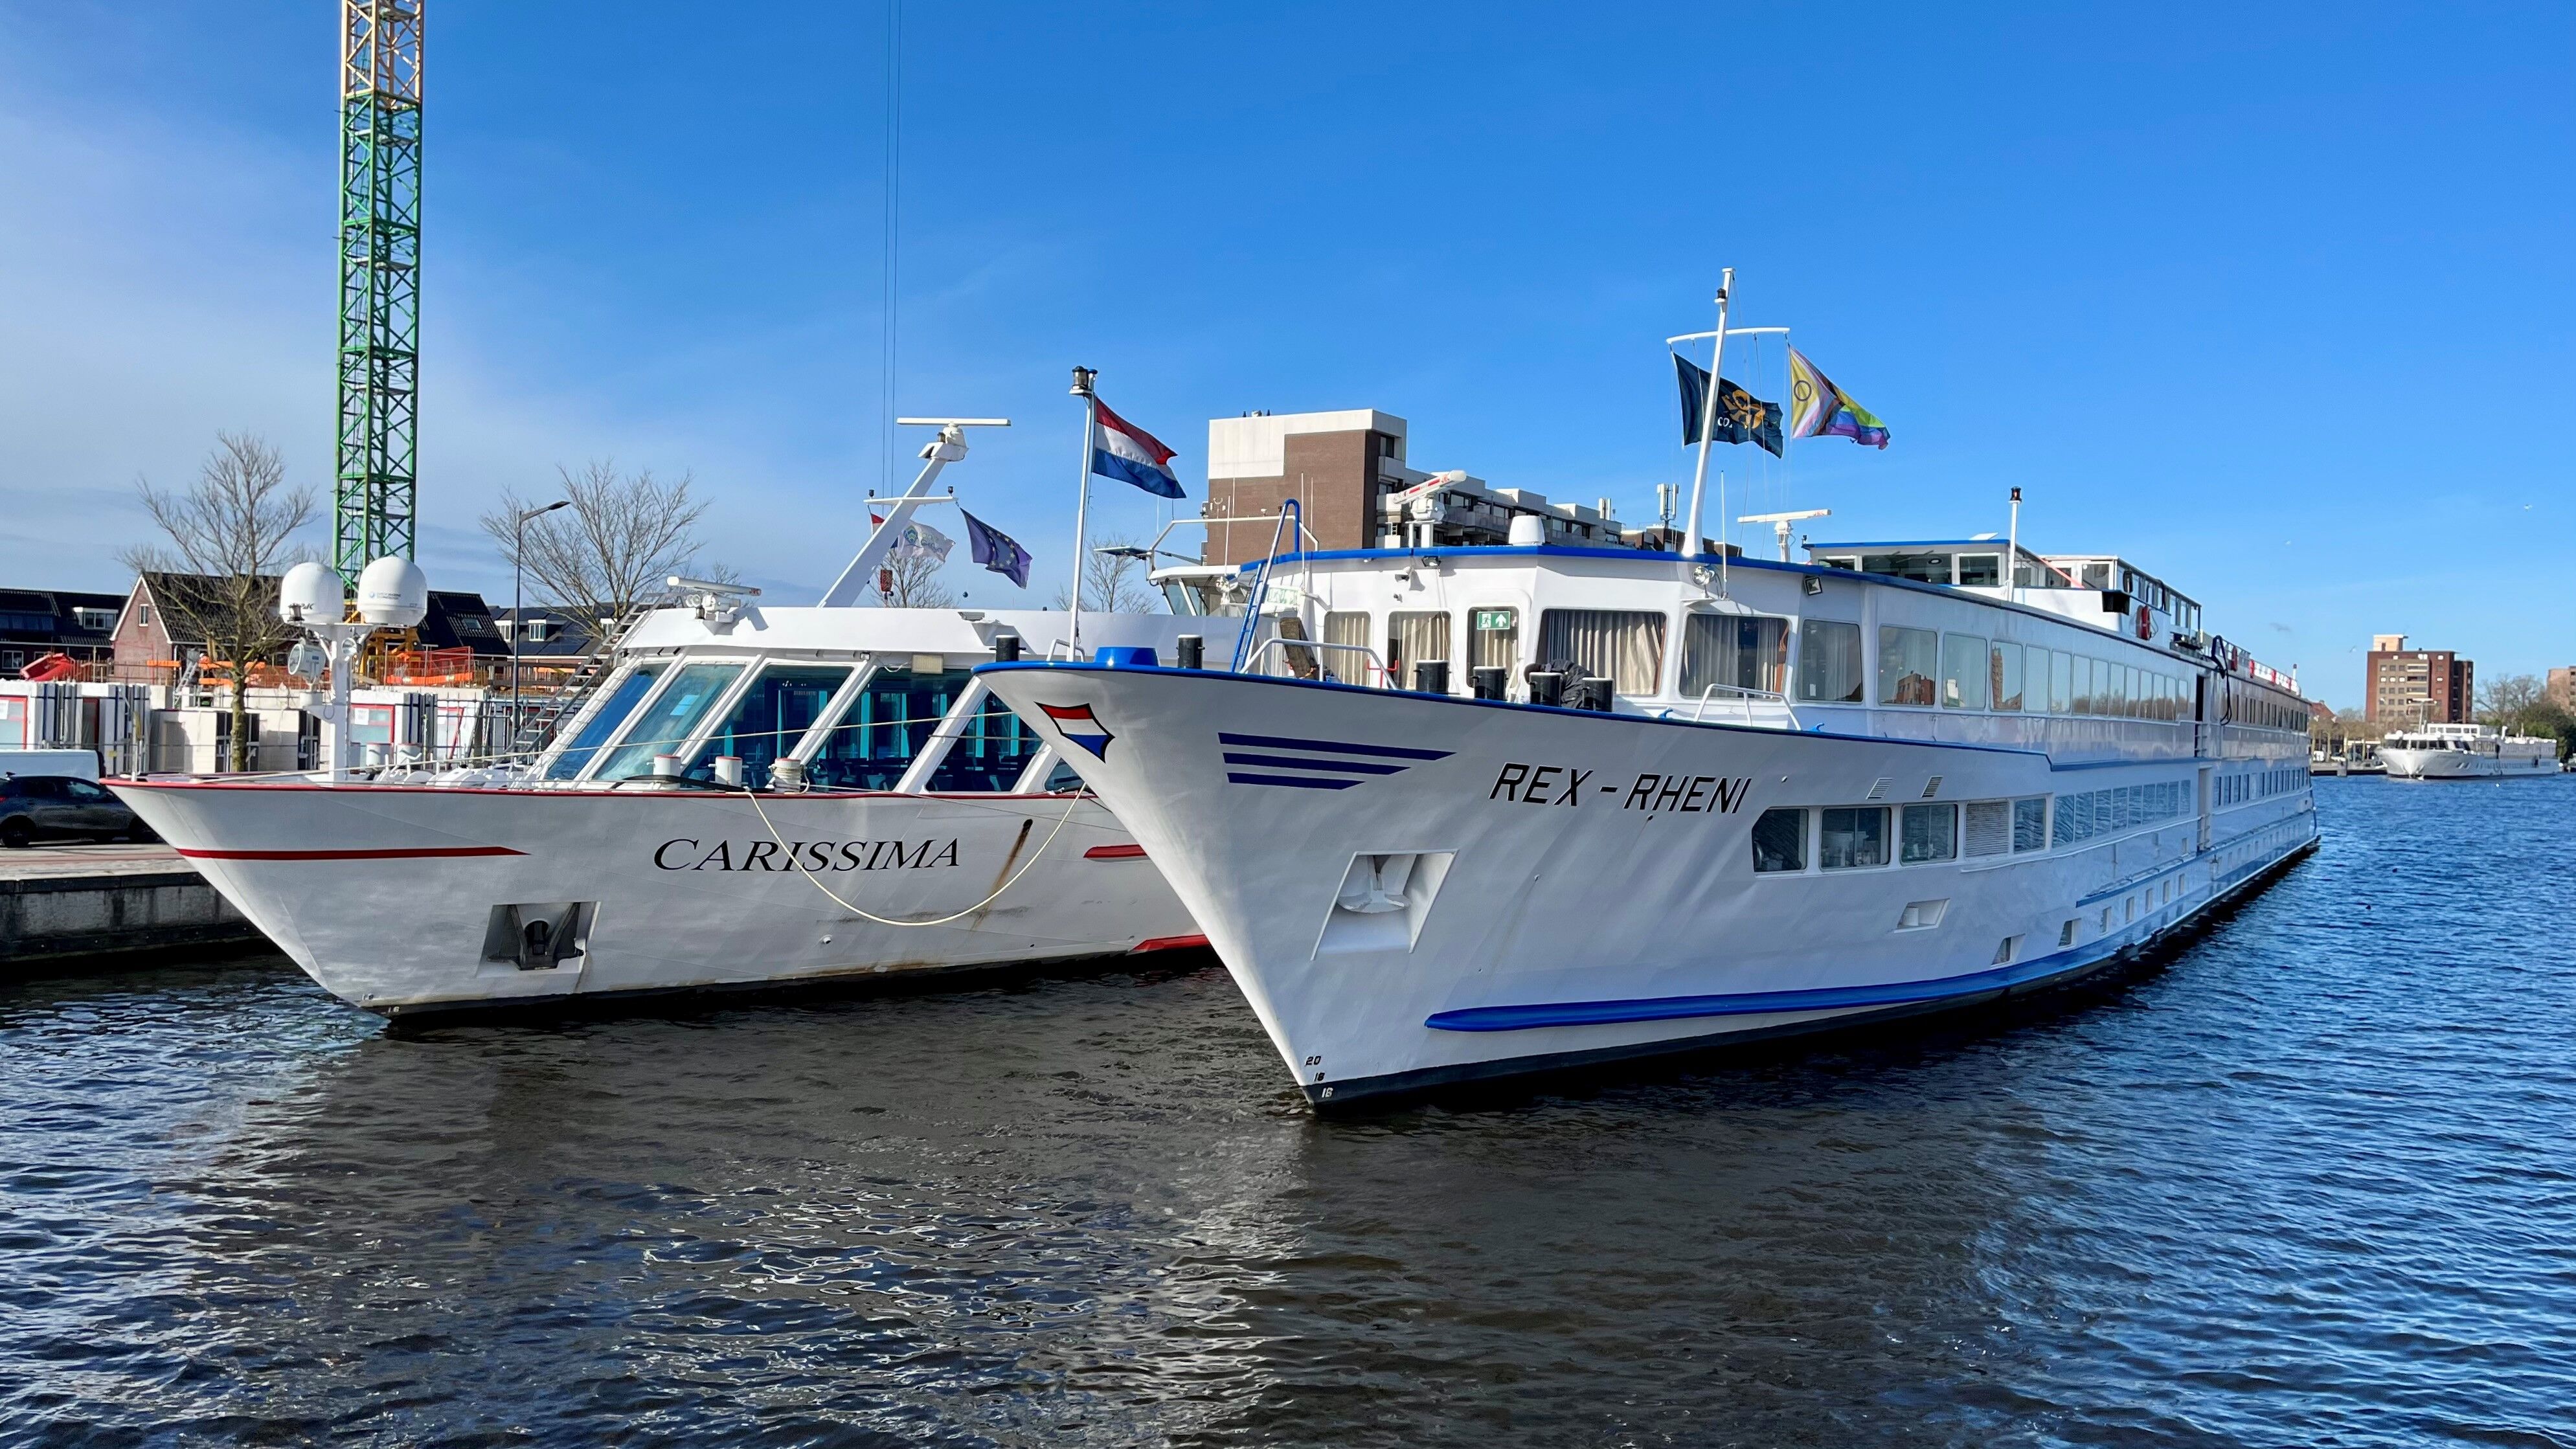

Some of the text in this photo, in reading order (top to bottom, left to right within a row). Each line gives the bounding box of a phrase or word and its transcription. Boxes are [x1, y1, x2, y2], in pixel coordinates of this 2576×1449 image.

[1489, 762, 1594, 807] REX
[1623, 773, 1752, 814] RHENI
[654, 838, 960, 872] CARISSIMA
[1305, 1055, 1322, 1066] 20
[1314, 1072, 1326, 1082] 18
[1322, 1088, 1333, 1098] 16
